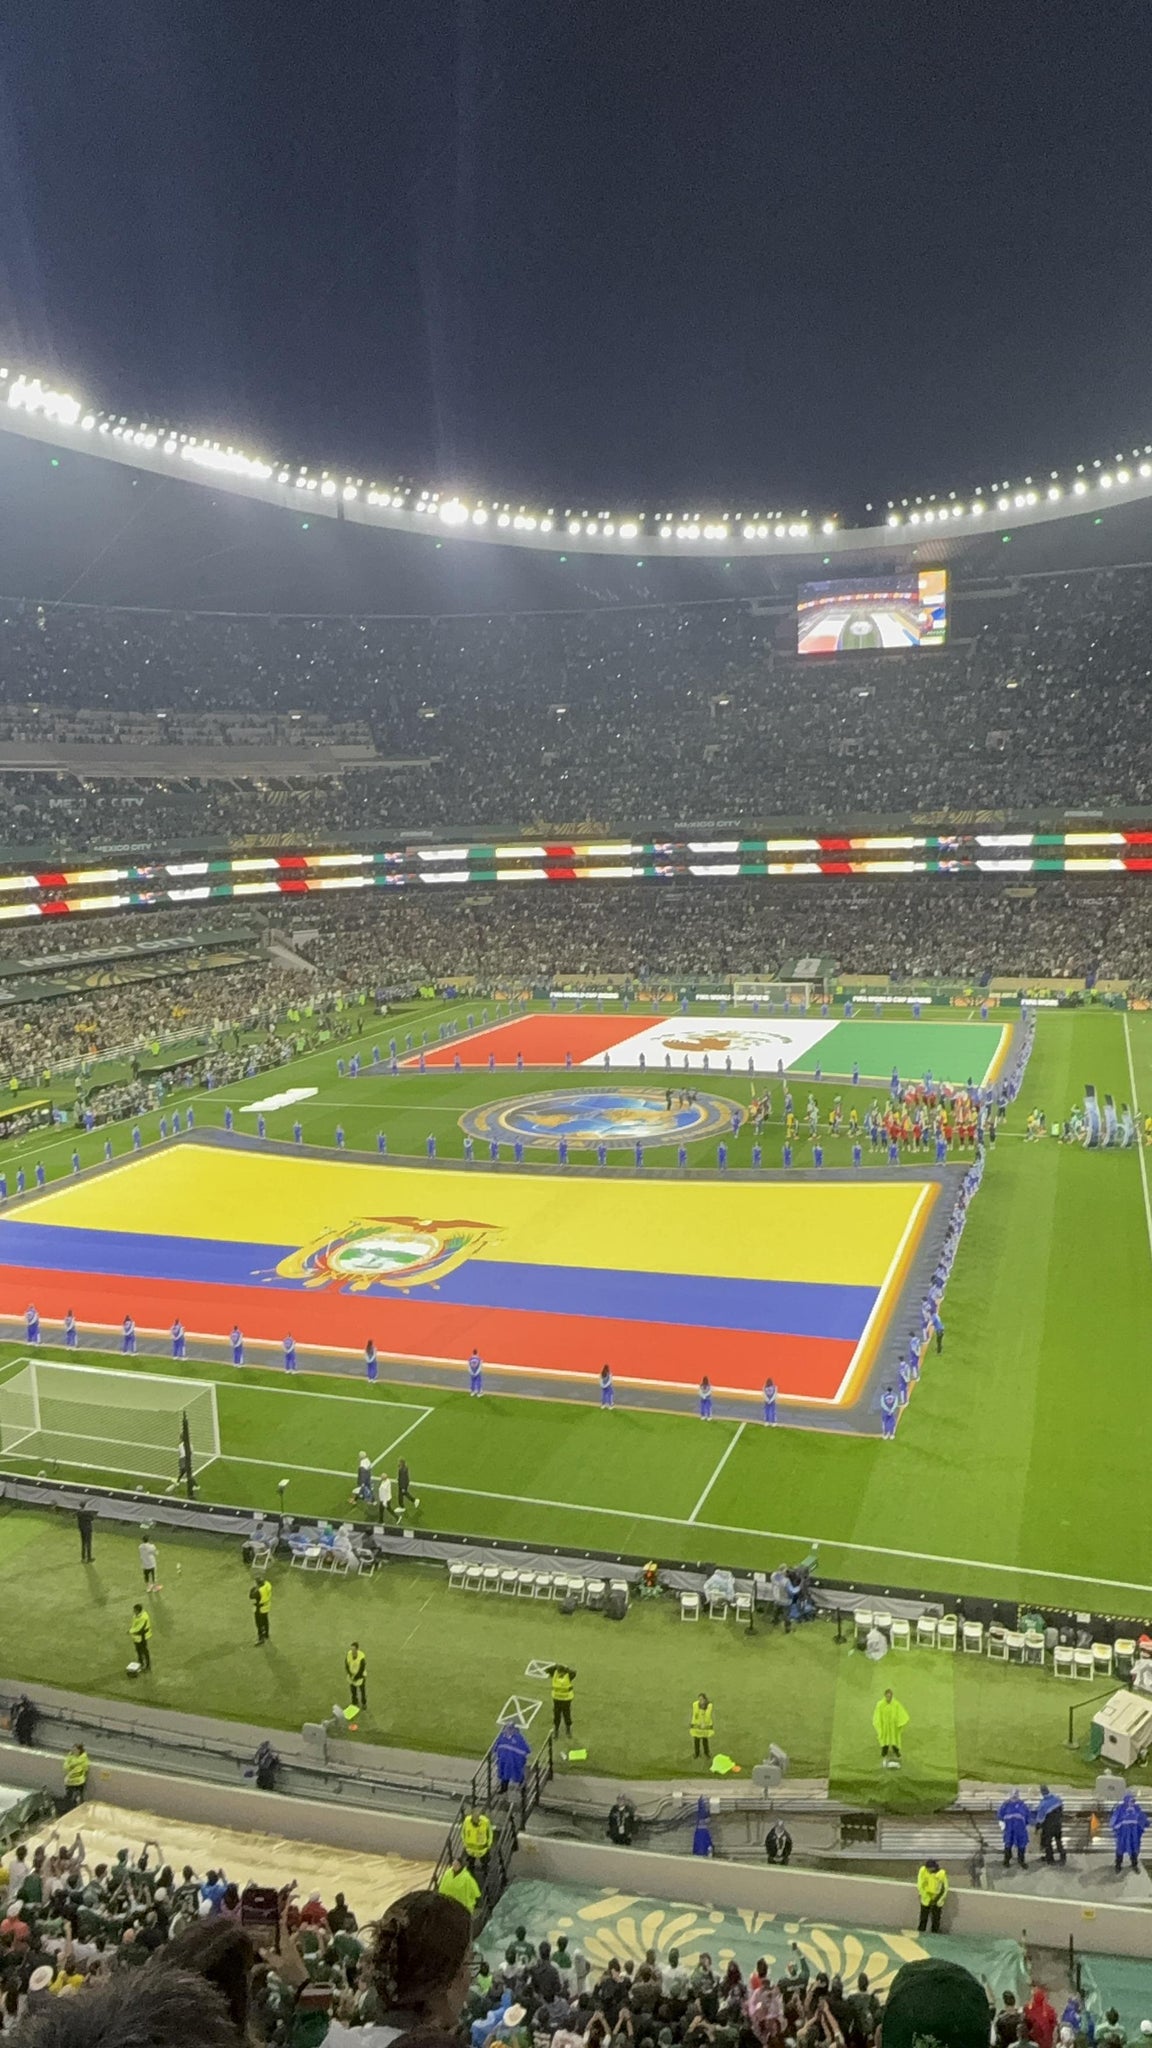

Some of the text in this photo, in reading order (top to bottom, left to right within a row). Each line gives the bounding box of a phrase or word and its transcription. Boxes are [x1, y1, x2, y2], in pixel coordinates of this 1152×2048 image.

[716, 820, 741, 828] CITY
[130, 843, 152, 851] CITY
[18, 936, 195, 967] MEXICO CITY
